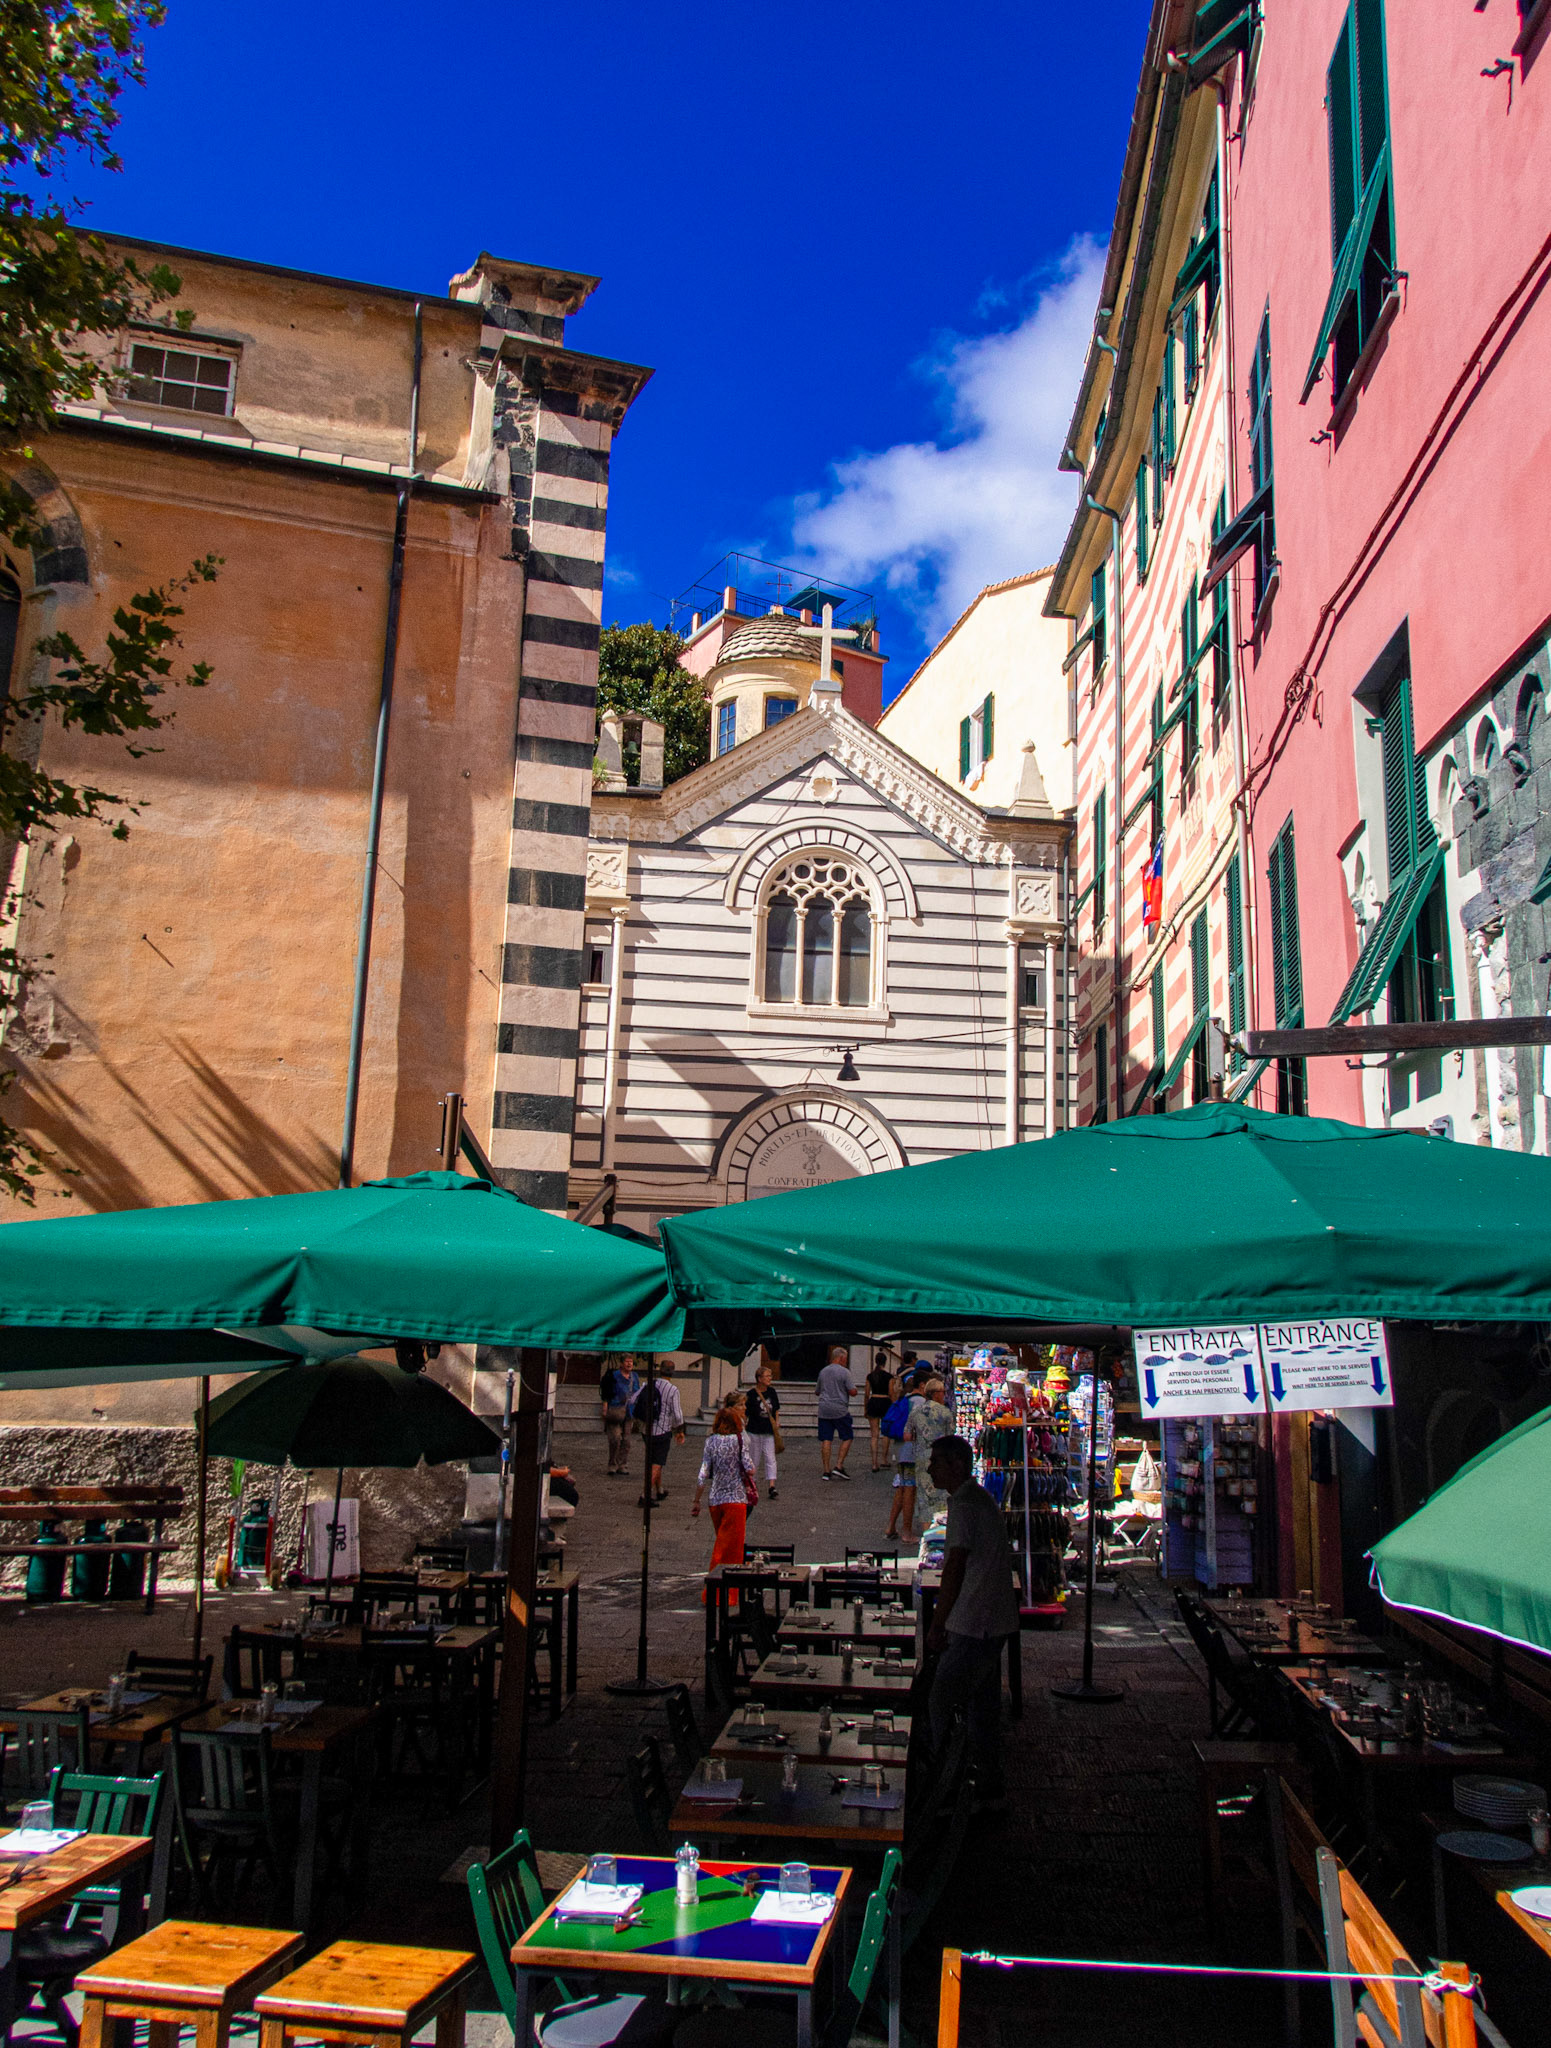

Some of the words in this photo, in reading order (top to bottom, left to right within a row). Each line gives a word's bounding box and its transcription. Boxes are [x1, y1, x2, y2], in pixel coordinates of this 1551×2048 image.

[759, 1134, 791, 1167] MORTIS
[1150, 1331, 1244, 1352] ENTRATA
[1265, 1322, 1379, 1346] ENTRANCE
[1203, 1386, 1240, 1394] PRENOTATO!
